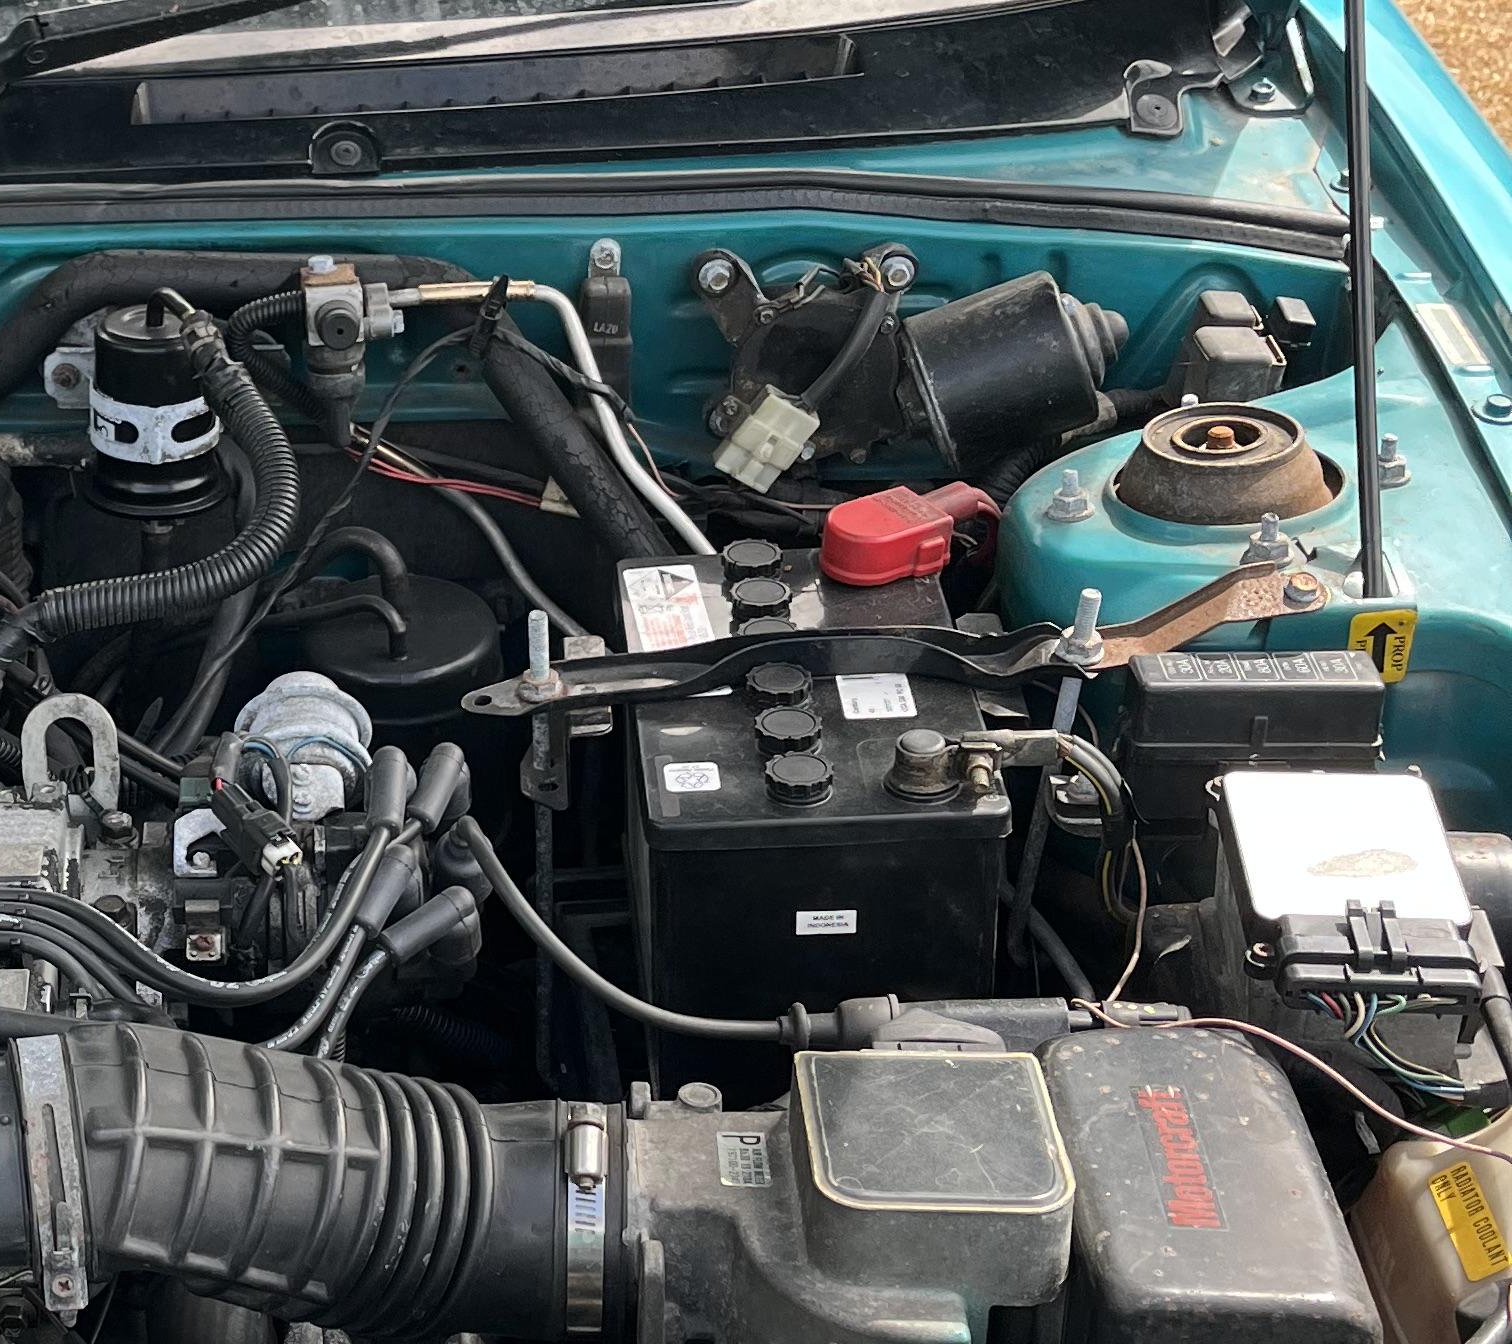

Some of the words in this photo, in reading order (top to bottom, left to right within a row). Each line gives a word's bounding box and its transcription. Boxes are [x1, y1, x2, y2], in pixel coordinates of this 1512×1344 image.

[1391, 635, 1406, 672] PROP
[1137, 1087, 1221, 1227] Motorcraft
[1450, 1165, 1484, 1217] RADIATOR
[1472, 1216, 1508, 1266] COOLANT
